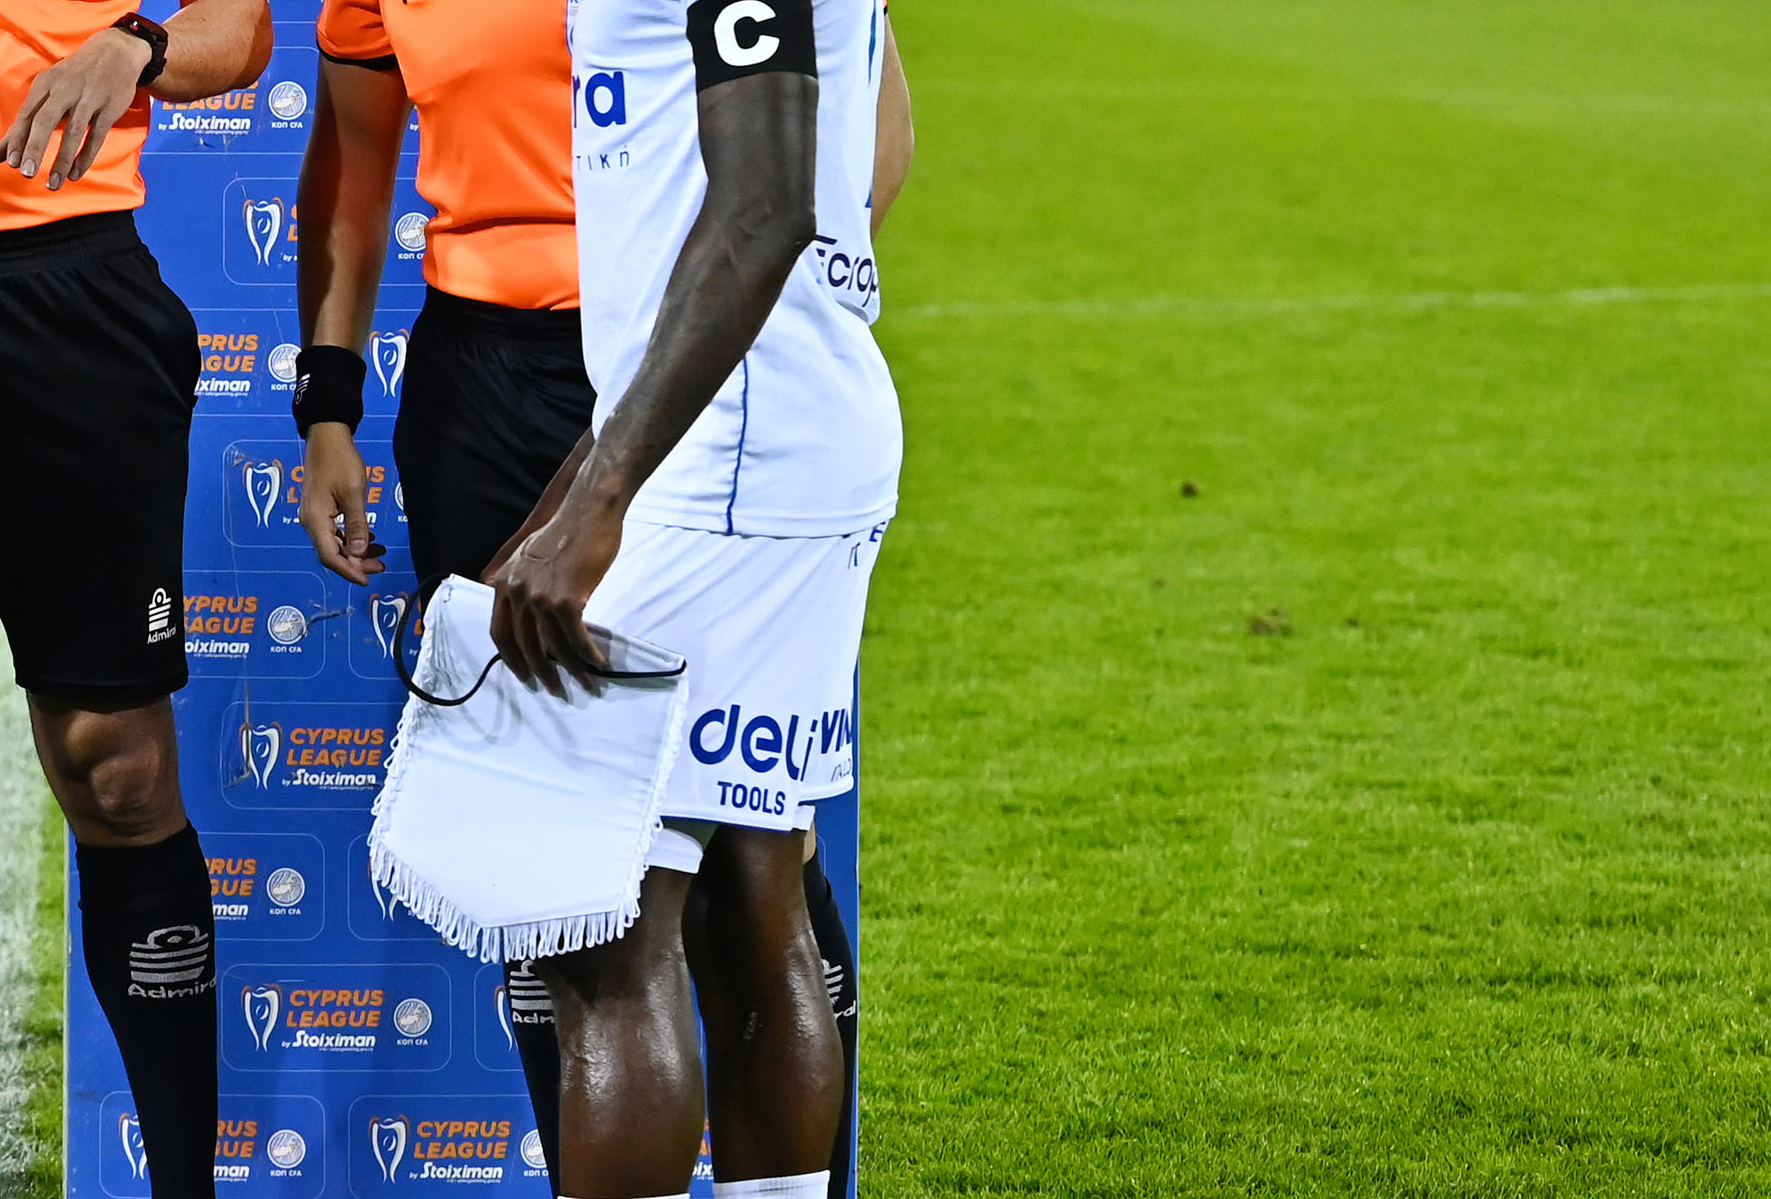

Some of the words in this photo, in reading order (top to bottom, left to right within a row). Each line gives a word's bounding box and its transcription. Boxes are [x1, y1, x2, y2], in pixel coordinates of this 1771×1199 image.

[714, 0, 780, 67] C
[291, 728, 384, 745] CYPRUS
[288, 749, 382, 766] LEAGUE
[293, 769, 376, 786] Stoiximan
[717, 780, 786, 816] TOOLS
[291, 990, 384, 1006] CYPRUS
[287, 1011, 381, 1027] LEAGUE
[292, 1030, 376, 1047] Stoiximan
[418, 1121, 511, 1137] CYPRUS
[415, 1142, 508, 1158] LEAGUE
[420, 1162, 503, 1180] Stoiximan
